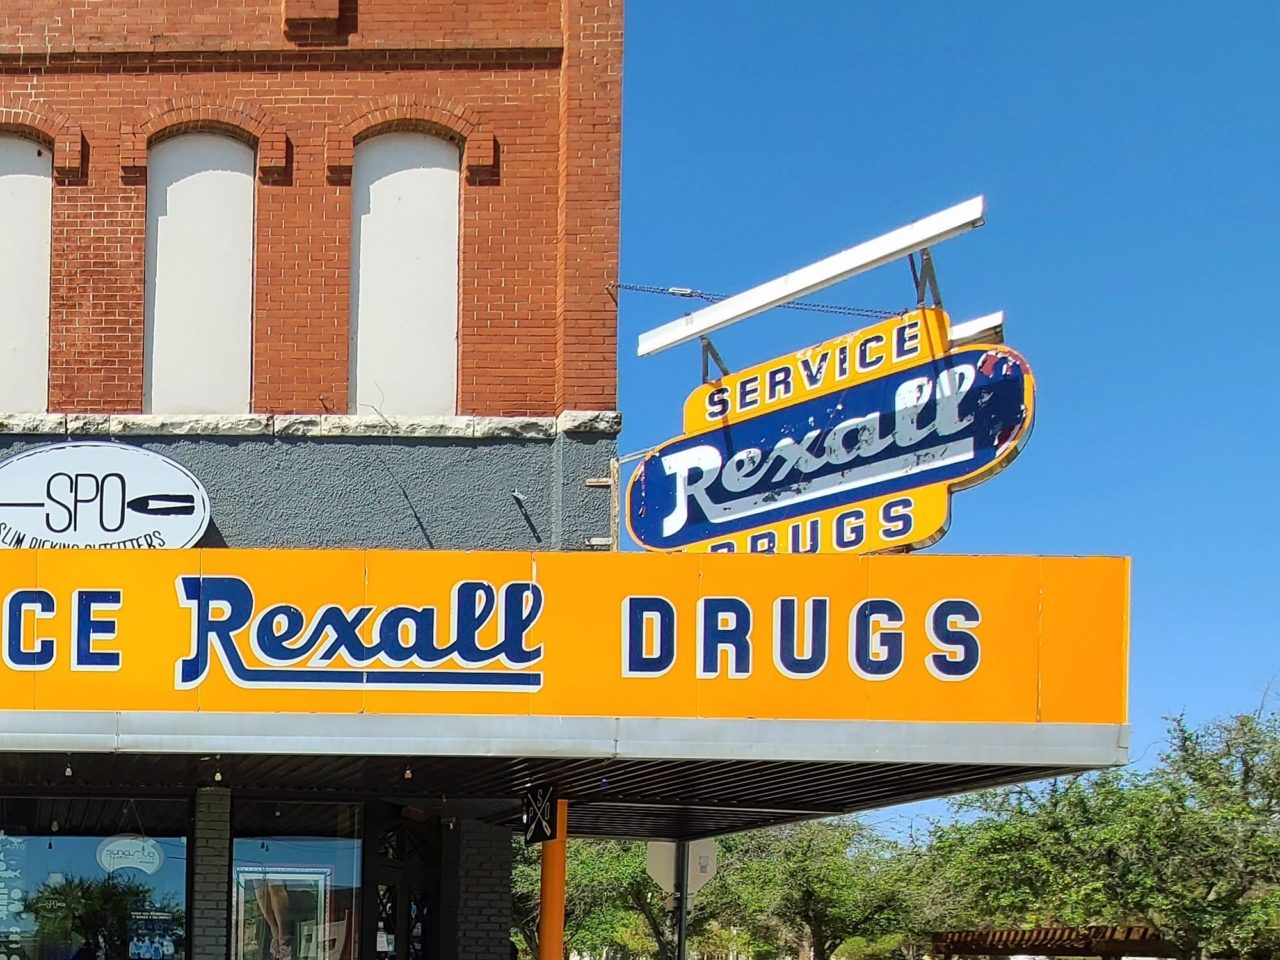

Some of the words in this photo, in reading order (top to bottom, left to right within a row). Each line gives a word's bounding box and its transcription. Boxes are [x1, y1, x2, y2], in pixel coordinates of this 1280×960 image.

[705, 320, 921, 422] SERVICE
[45, 472, 127, 533] SPO
[662, 364, 975, 537] Rexall
[175, 574, 544, 691] Rexall
[621, 595, 983, 681] DRUGS
